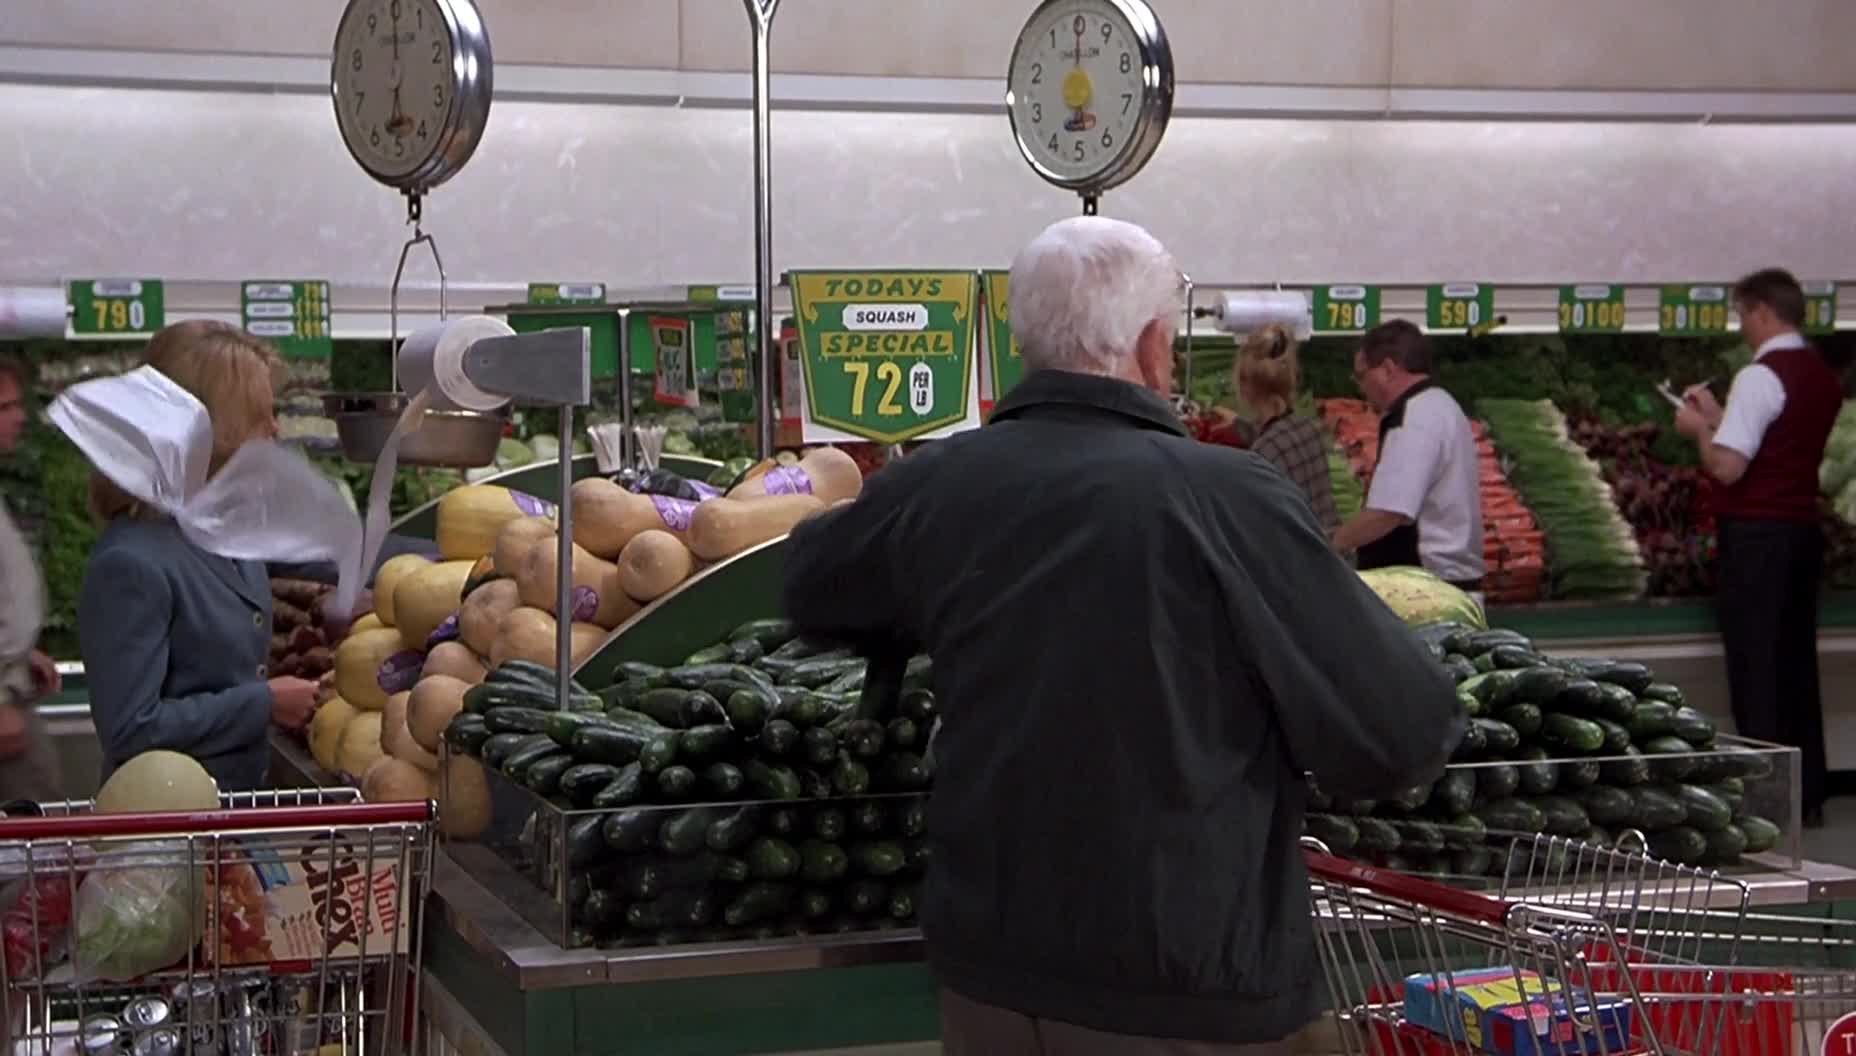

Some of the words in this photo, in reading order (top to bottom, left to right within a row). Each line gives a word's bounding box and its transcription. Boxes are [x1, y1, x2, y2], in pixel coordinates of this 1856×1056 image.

[1073, 15, 1086, 35] 0
[1101, 23, 1112, 44] 9
[1049, 29, 1056, 48] 1
[352, 49, 362, 71] 8
[432, 42, 442, 64] 2
[1120, 53, 1131, 73] 8
[1032, 64, 1041, 84] 2
[355, 92, 365, 115] 7
[434, 85, 443, 107] 3
[1121, 94, 1132, 115] 7
[1032, 103, 1042, 123] 3
[370, 125, 380, 146] 6
[417, 120, 427, 141] 4
[1101, 128, 1113, 148] 6
[395, 136, 404, 157] 5
[1048, 133, 1059, 152] 4
[1074, 141, 1085, 162] 5
[825, 278, 943, 297] TODAY'S
[856, 311, 916, 323] SQUASH
[827, 334, 949, 353] SPECIAL
[844, 362, 903, 416] 72
[913, 371, 929, 388] PER
[916, 390, 928, 406] LB
[301, 832, 359, 954] Chex
